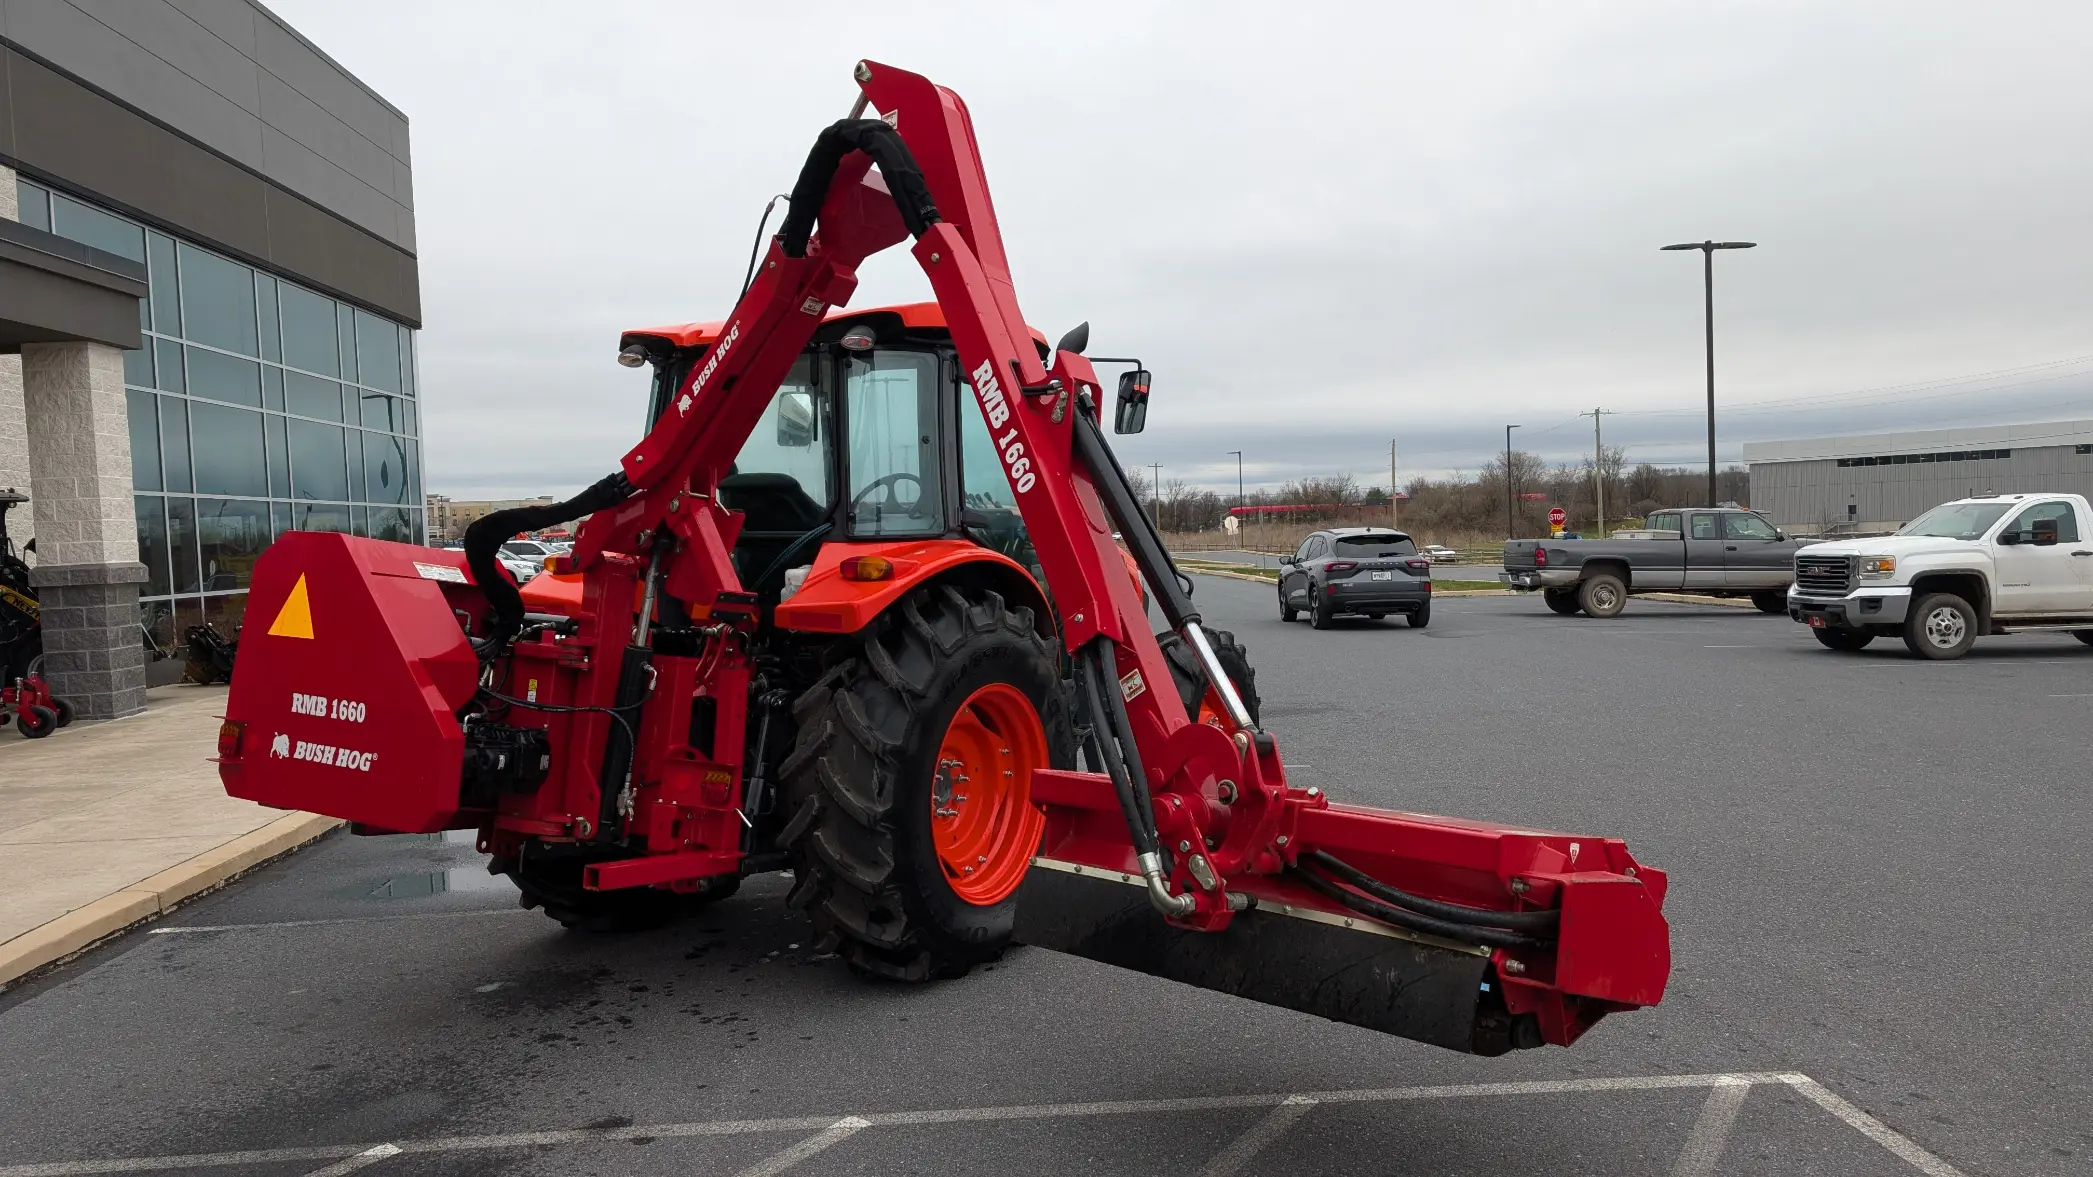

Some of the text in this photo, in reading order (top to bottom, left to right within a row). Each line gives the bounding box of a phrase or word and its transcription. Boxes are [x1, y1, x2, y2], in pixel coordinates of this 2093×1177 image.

[692, 354, 718, 397] BUSH
[972, 358, 1036, 494] RMB 1660
[1550, 513, 1565, 521] STOP
[291, 692, 366, 723] RMB 1660
[293, 740, 337, 765] BUSH
